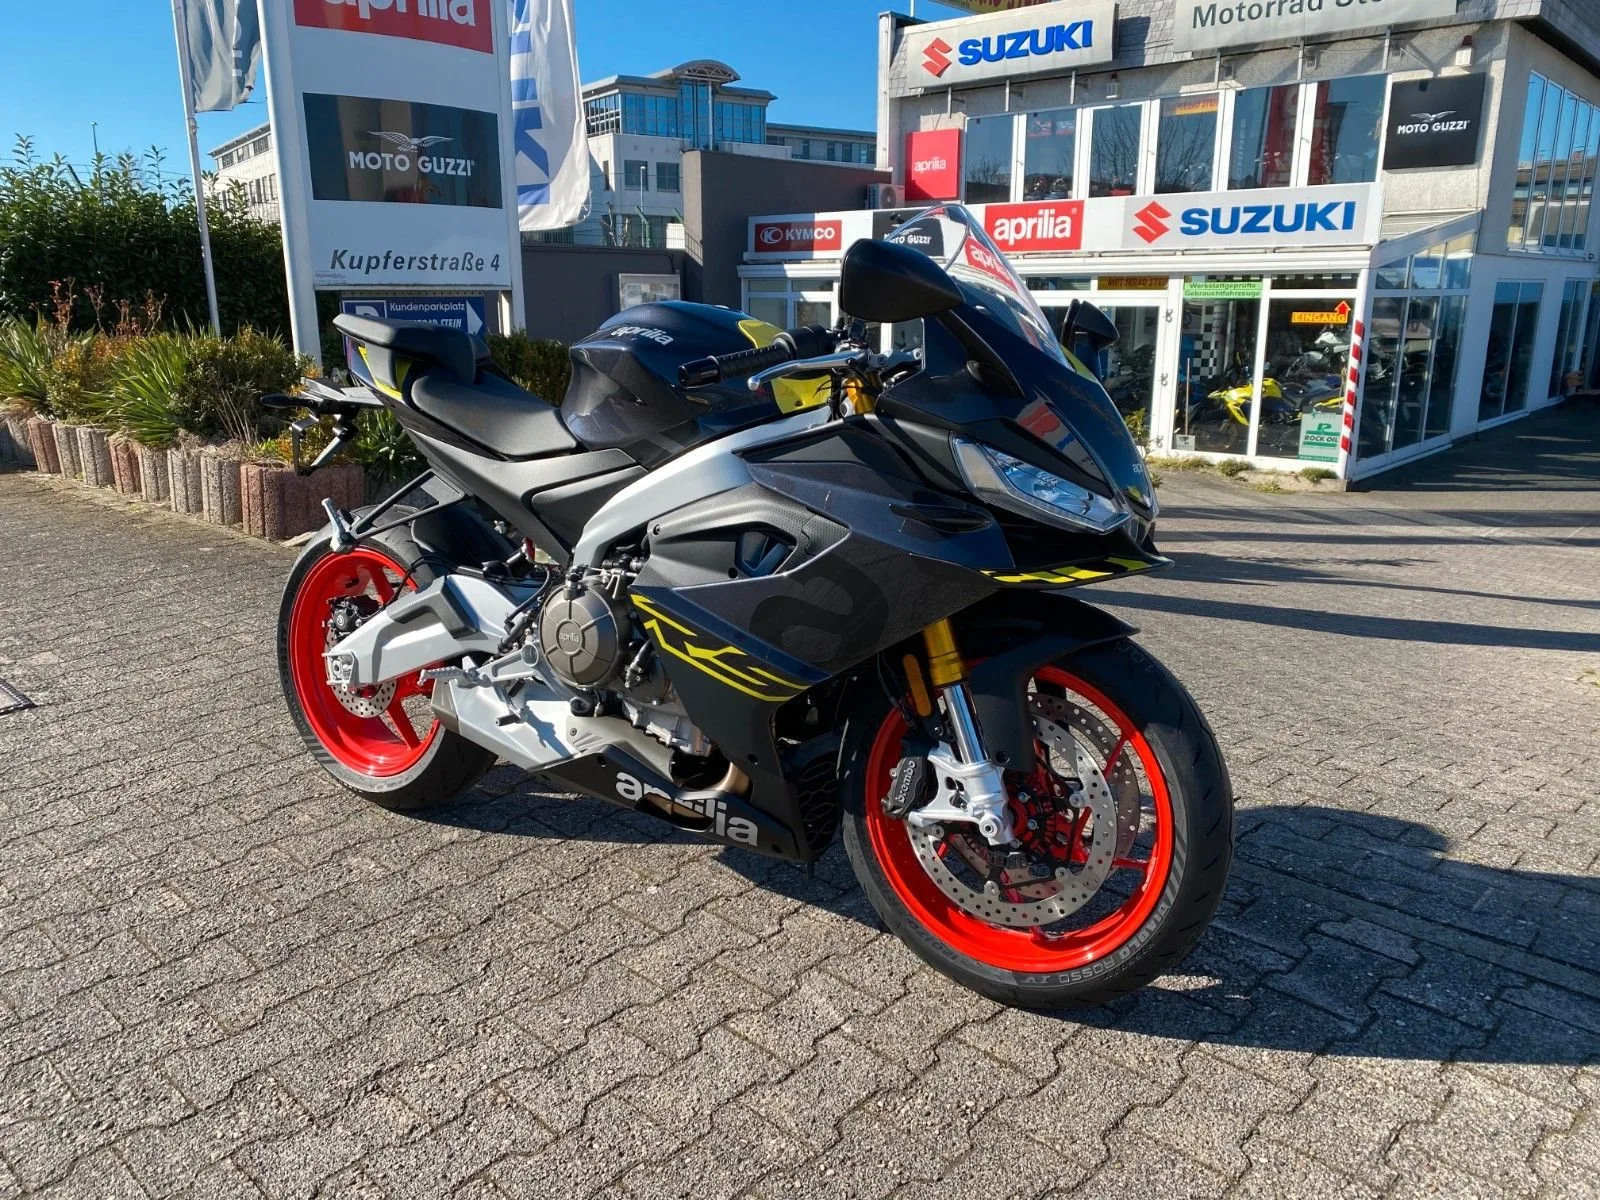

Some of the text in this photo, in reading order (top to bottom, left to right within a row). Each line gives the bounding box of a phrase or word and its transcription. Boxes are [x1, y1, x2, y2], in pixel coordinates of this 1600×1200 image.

[958, 20, 1093, 66] SUZUKI
[1397, 120, 1468, 135] MOTO GUZZI
[349, 151, 472, 176] MOTO GUZZI
[914, 157, 947, 173] aprilia
[993, 208, 1072, 246] aprilia
[1179, 201, 1357, 236] SUZUKI
[785, 227, 836, 242] KYMCO
[907, 234, 931, 245] GUZZI
[330, 250, 501, 275] Kupferstraße 4
[1184, 289, 1261, 298] Gebrauchtfahrzeuge
[1189, 282, 1257, 291] Werkstattgeprüfte
[389, 302, 466, 313] Kundenparkplatz
[1292, 312, 1345, 323] EINGANG
[610, 326, 674, 346] aprilia
[894, 760, 916, 804] brembo
[1119, 902, 1171, 958] DIABLO
[1058, 956, 1116, 984] ROSSO
